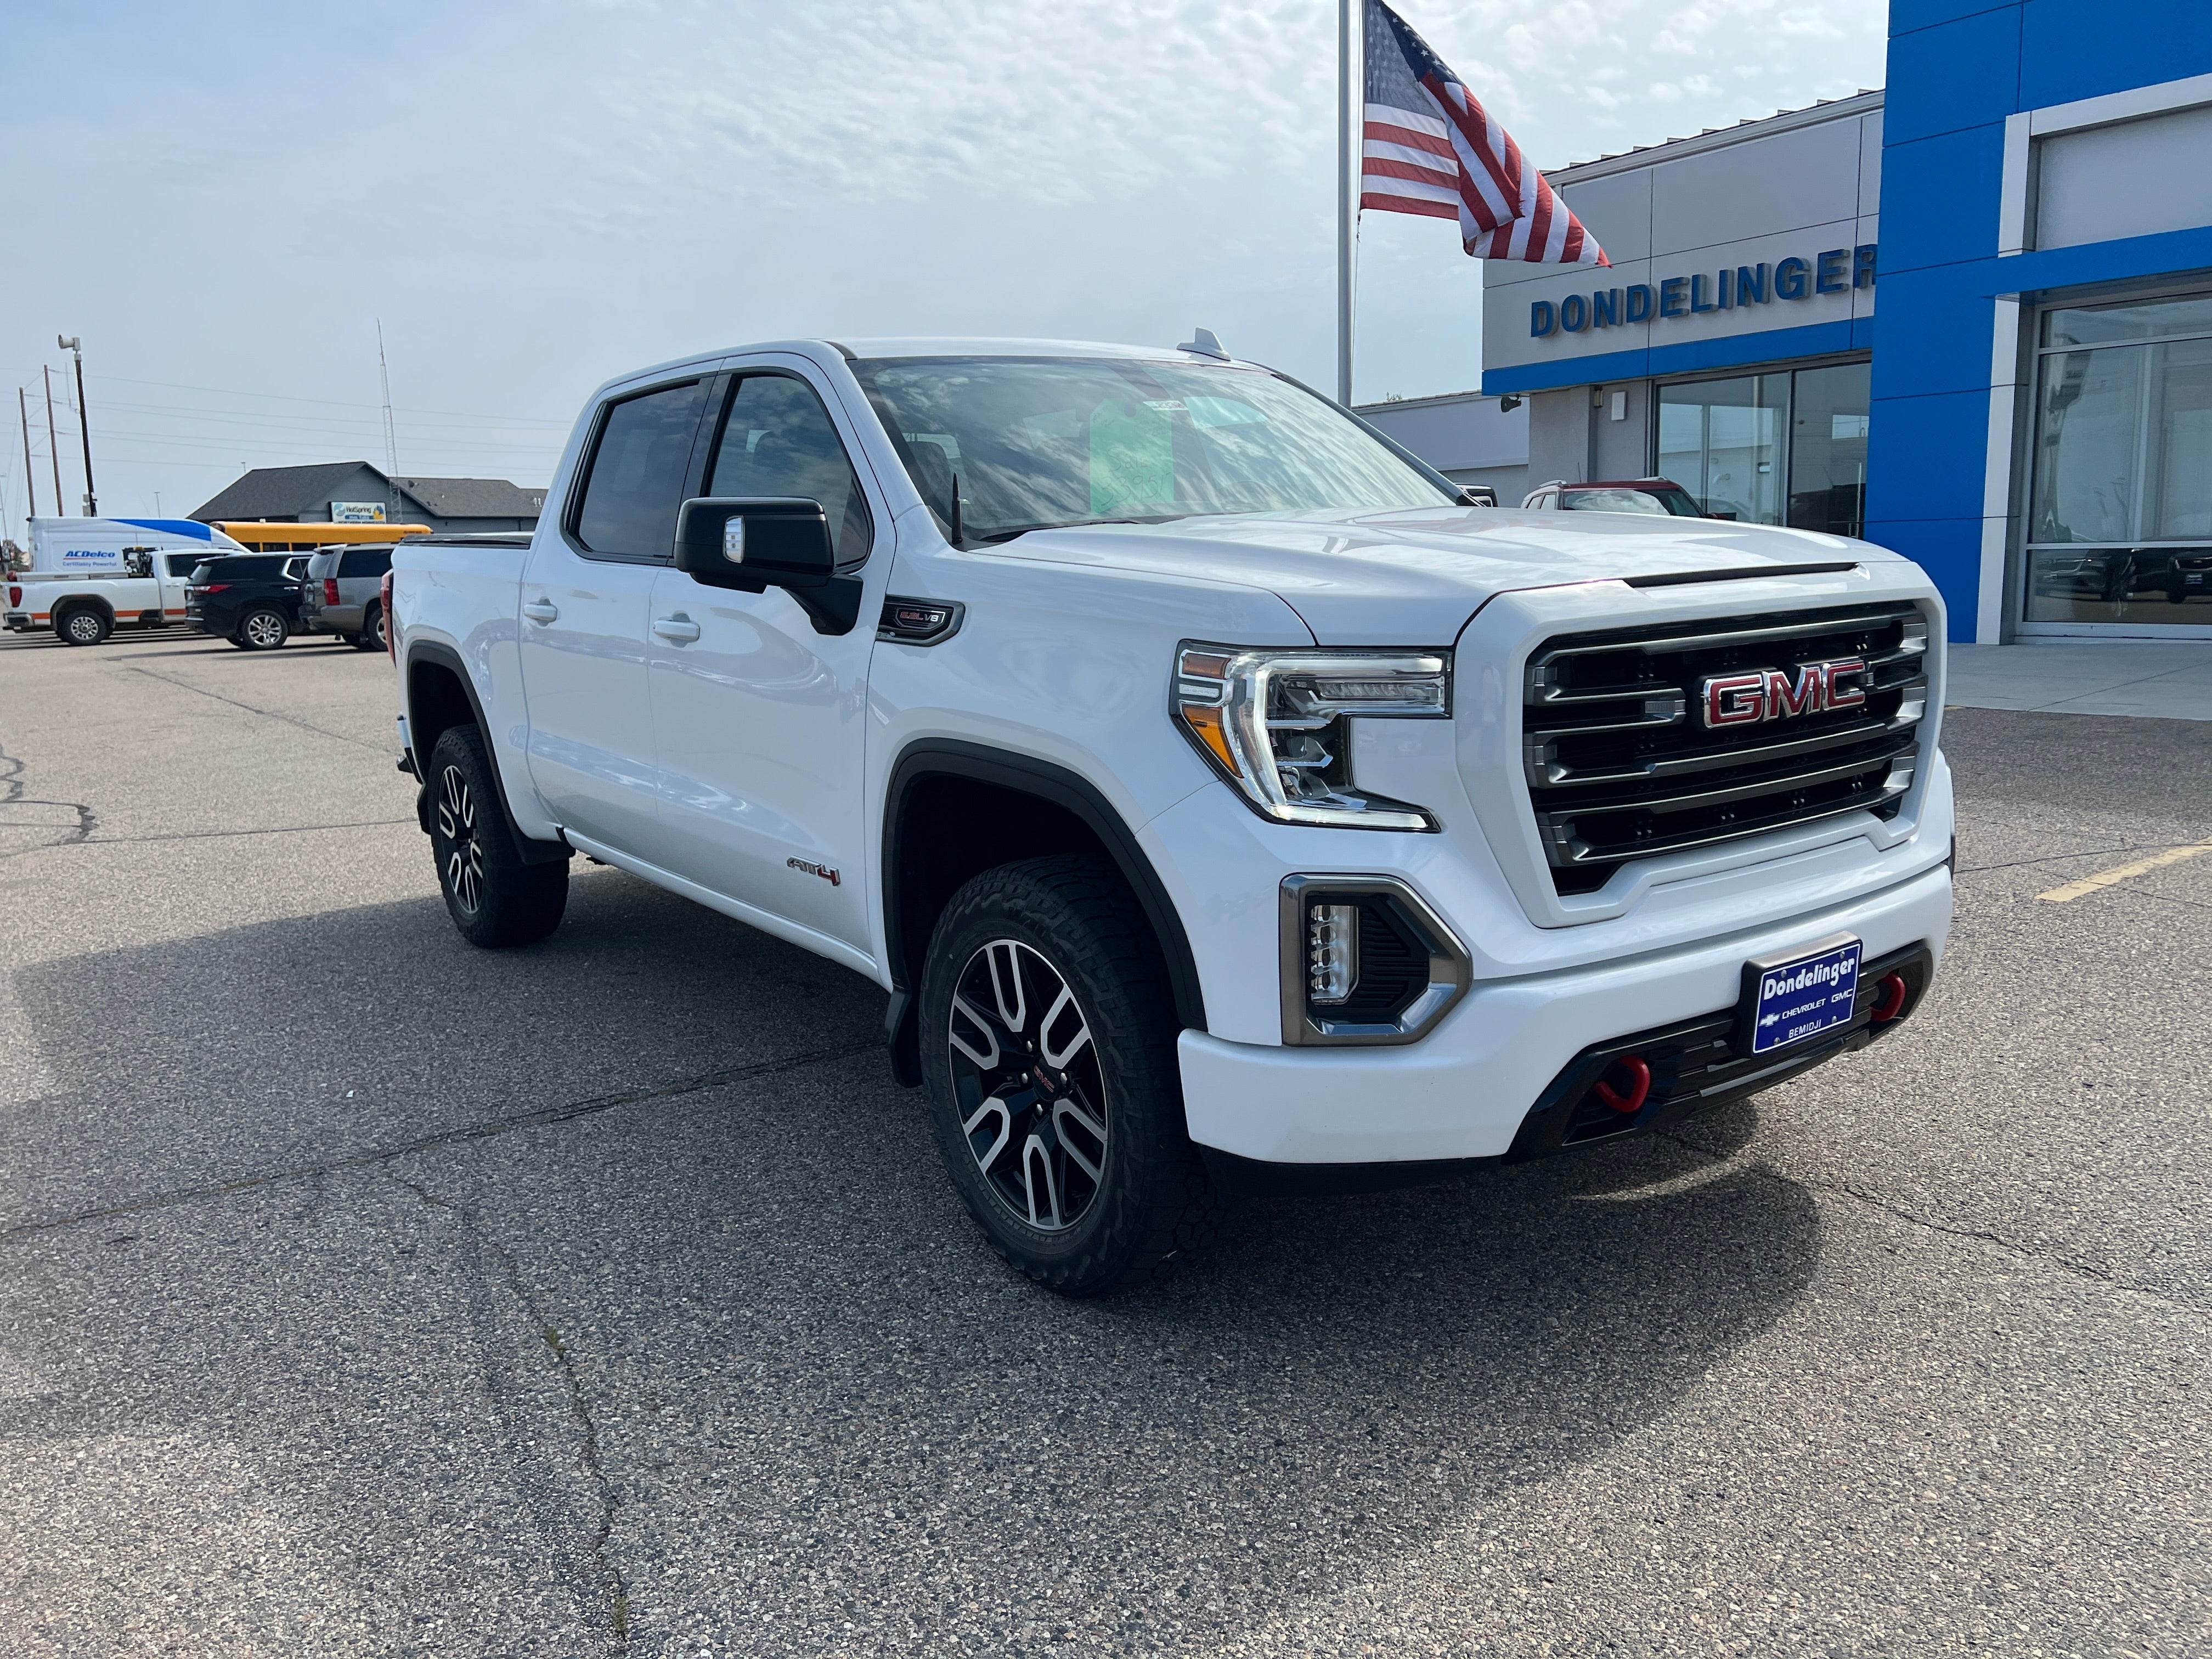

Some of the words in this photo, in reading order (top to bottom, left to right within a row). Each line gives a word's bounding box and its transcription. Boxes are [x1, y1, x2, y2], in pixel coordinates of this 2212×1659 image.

[1531, 244, 1877, 338] DONDELINGER
[1703, 661, 1866, 729] GMC
[786, 855, 841, 887] AT4
[1764, 958, 1855, 1000] Dondelinger
[1781, 998, 1826, 1020] CHEVROLET
[1831, 989, 1853, 1003] GMC
[1788, 1019, 1822, 1039] BEMIDJI
[1034, 1065, 1055, 1093] GMC
